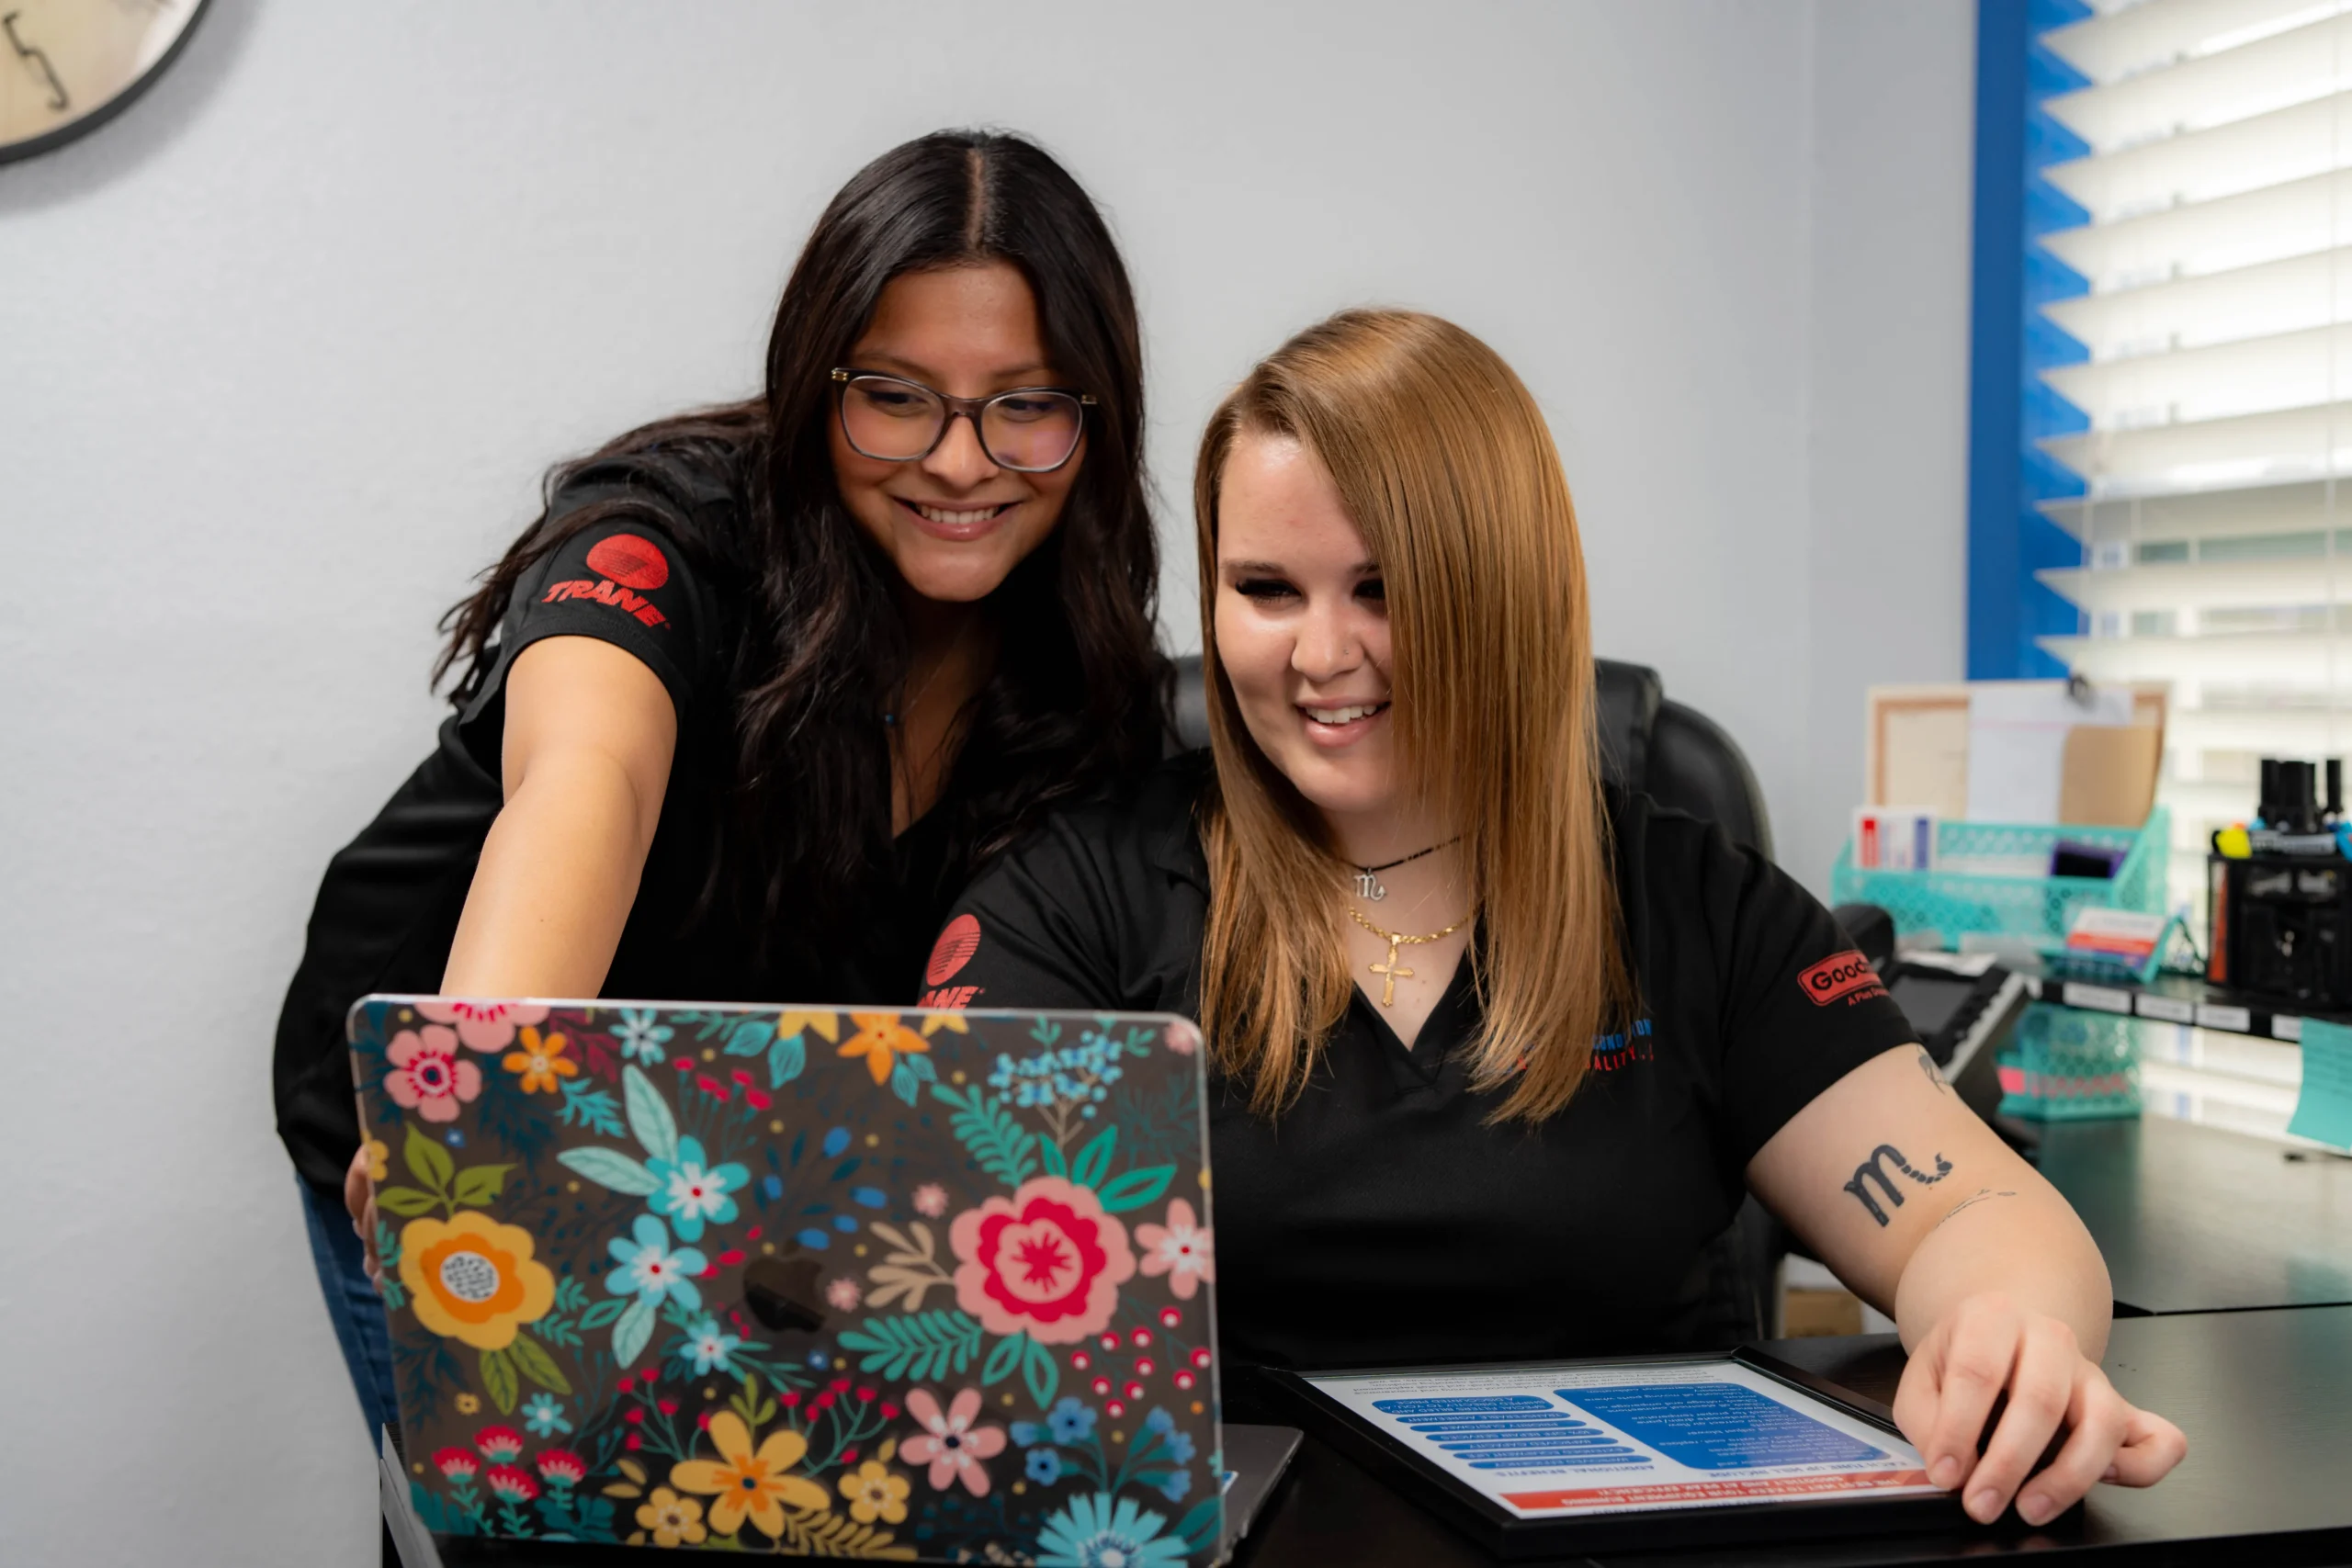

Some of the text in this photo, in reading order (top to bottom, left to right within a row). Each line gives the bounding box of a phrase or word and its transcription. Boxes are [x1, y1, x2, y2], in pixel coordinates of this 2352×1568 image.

[541, 580, 666, 627] TRANE
[1811, 956, 1870, 990] Good
[917, 986, 979, 1010] ANE
